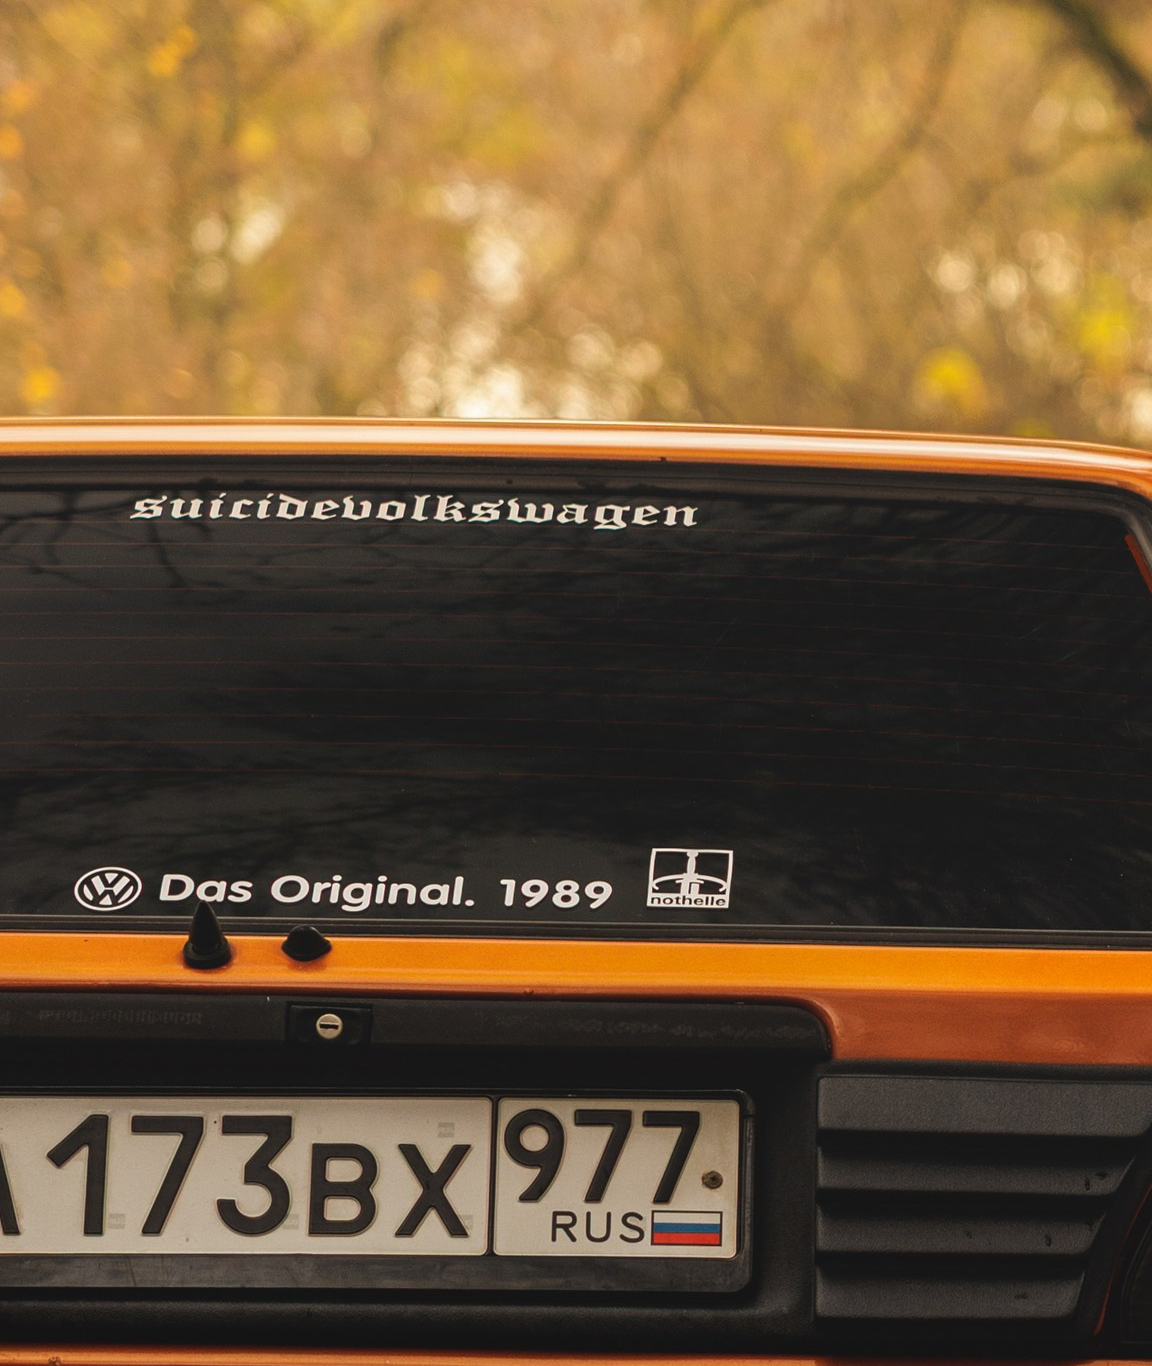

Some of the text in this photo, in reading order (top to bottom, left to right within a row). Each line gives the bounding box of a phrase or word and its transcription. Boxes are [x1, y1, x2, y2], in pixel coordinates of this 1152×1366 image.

[130, 493, 698, 530] suicidevolkswagen
[159, 873, 253, 903] Das
[270, 874, 475, 912] Original.
[499, 878, 613, 909] 1989
[650, 895, 726, 906] nothelle
[504, 1109, 701, 1204] 977
[551, 1210, 645, 1244] RUS
